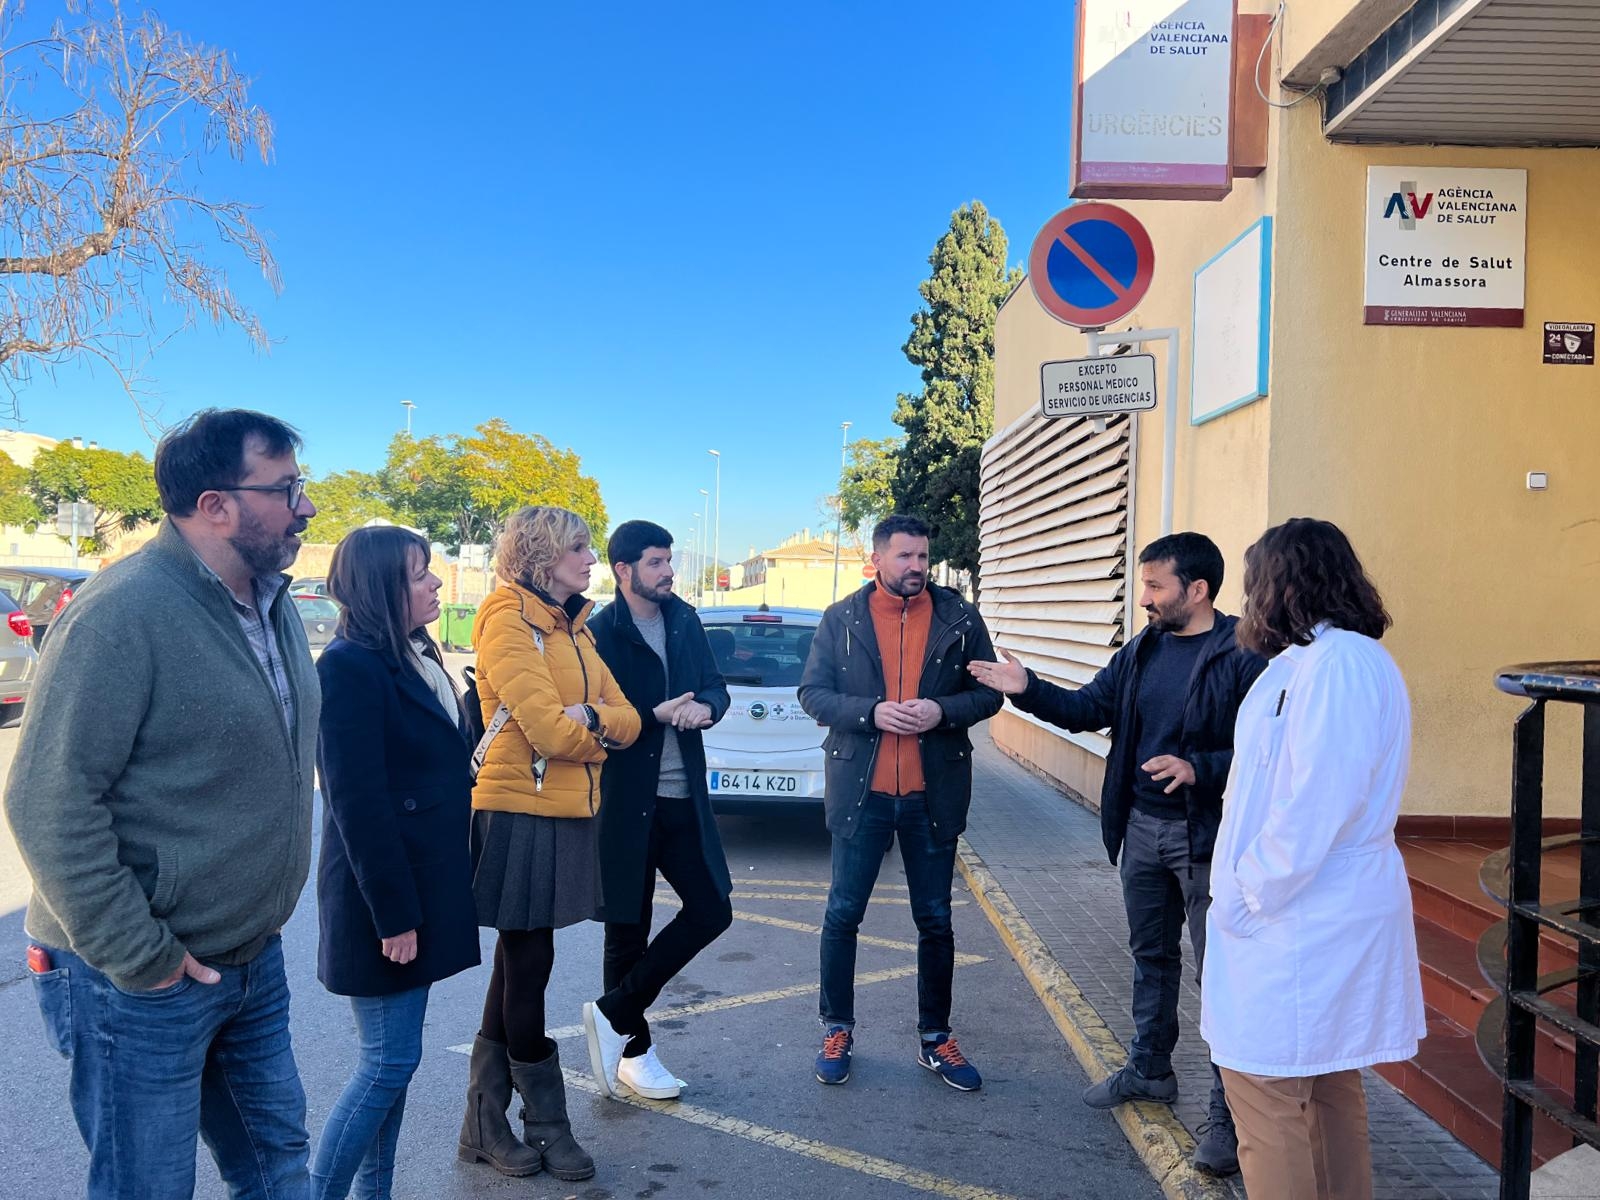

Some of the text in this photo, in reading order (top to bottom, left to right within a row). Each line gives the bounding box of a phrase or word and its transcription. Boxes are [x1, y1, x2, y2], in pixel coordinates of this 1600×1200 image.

[1150, 33, 1228, 43] VALENCIANA
[1150, 46, 1208, 55] DE SALUT
[1438, 186, 1494, 199] AGÈNCIA
[1438, 202, 1517, 212] VALENCIANA
[1437, 214, 1496, 225] DE SALUT
[1379, 254, 1513, 269] Centre de Salut
[1403, 274, 1487, 288] Almassora
[1430, 310, 1467, 318] VALENCIANA
[1549, 333, 1561, 343] 24
[1078, 363, 1117, 376] EXCEPTO
[1058, 377, 1138, 393] PERSONAL MEDICO
[1048, 391, 1151, 409] SERVICIO DE URGENCIAS
[721, 774, 796, 792] 6414 KZD
